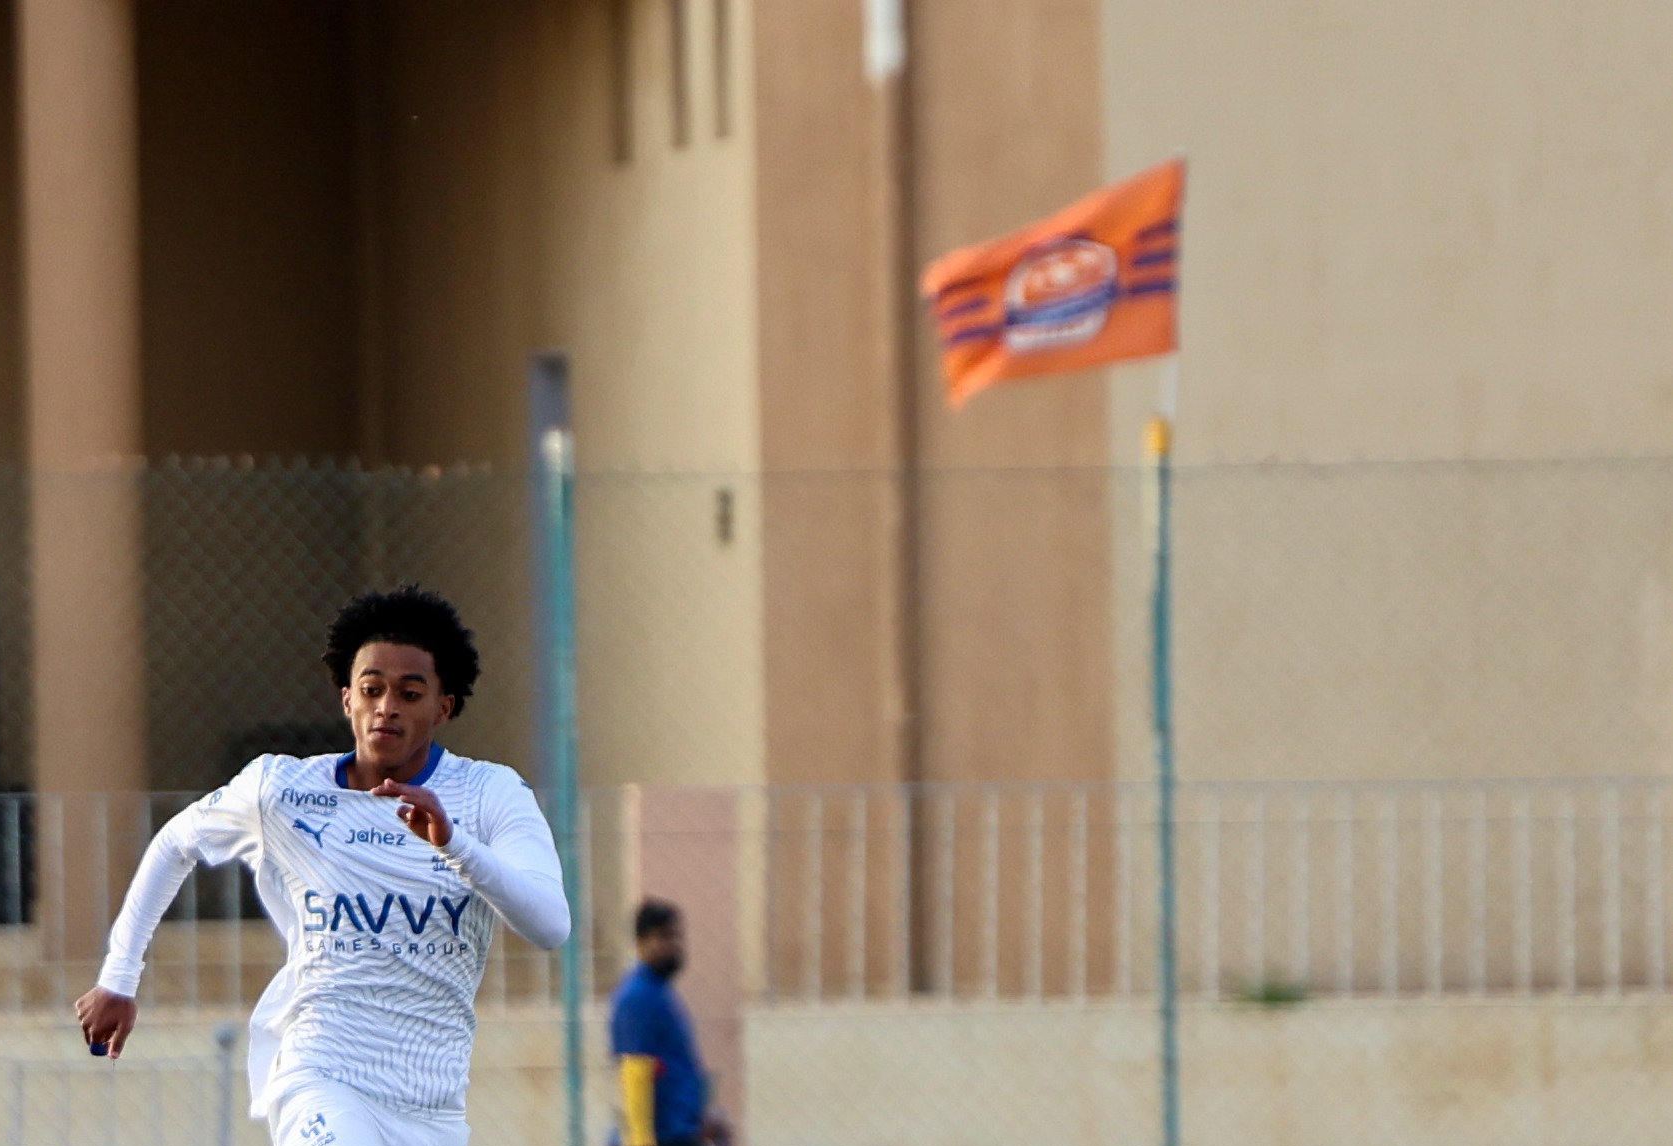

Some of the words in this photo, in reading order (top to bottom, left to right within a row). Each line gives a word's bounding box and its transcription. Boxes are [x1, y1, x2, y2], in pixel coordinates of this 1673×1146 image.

[281, 787, 338, 807] flynas
[304, 889, 470, 936] SAVVY
[306, 938, 382, 952] GAMES
[392, 942, 469, 955] GROUP
